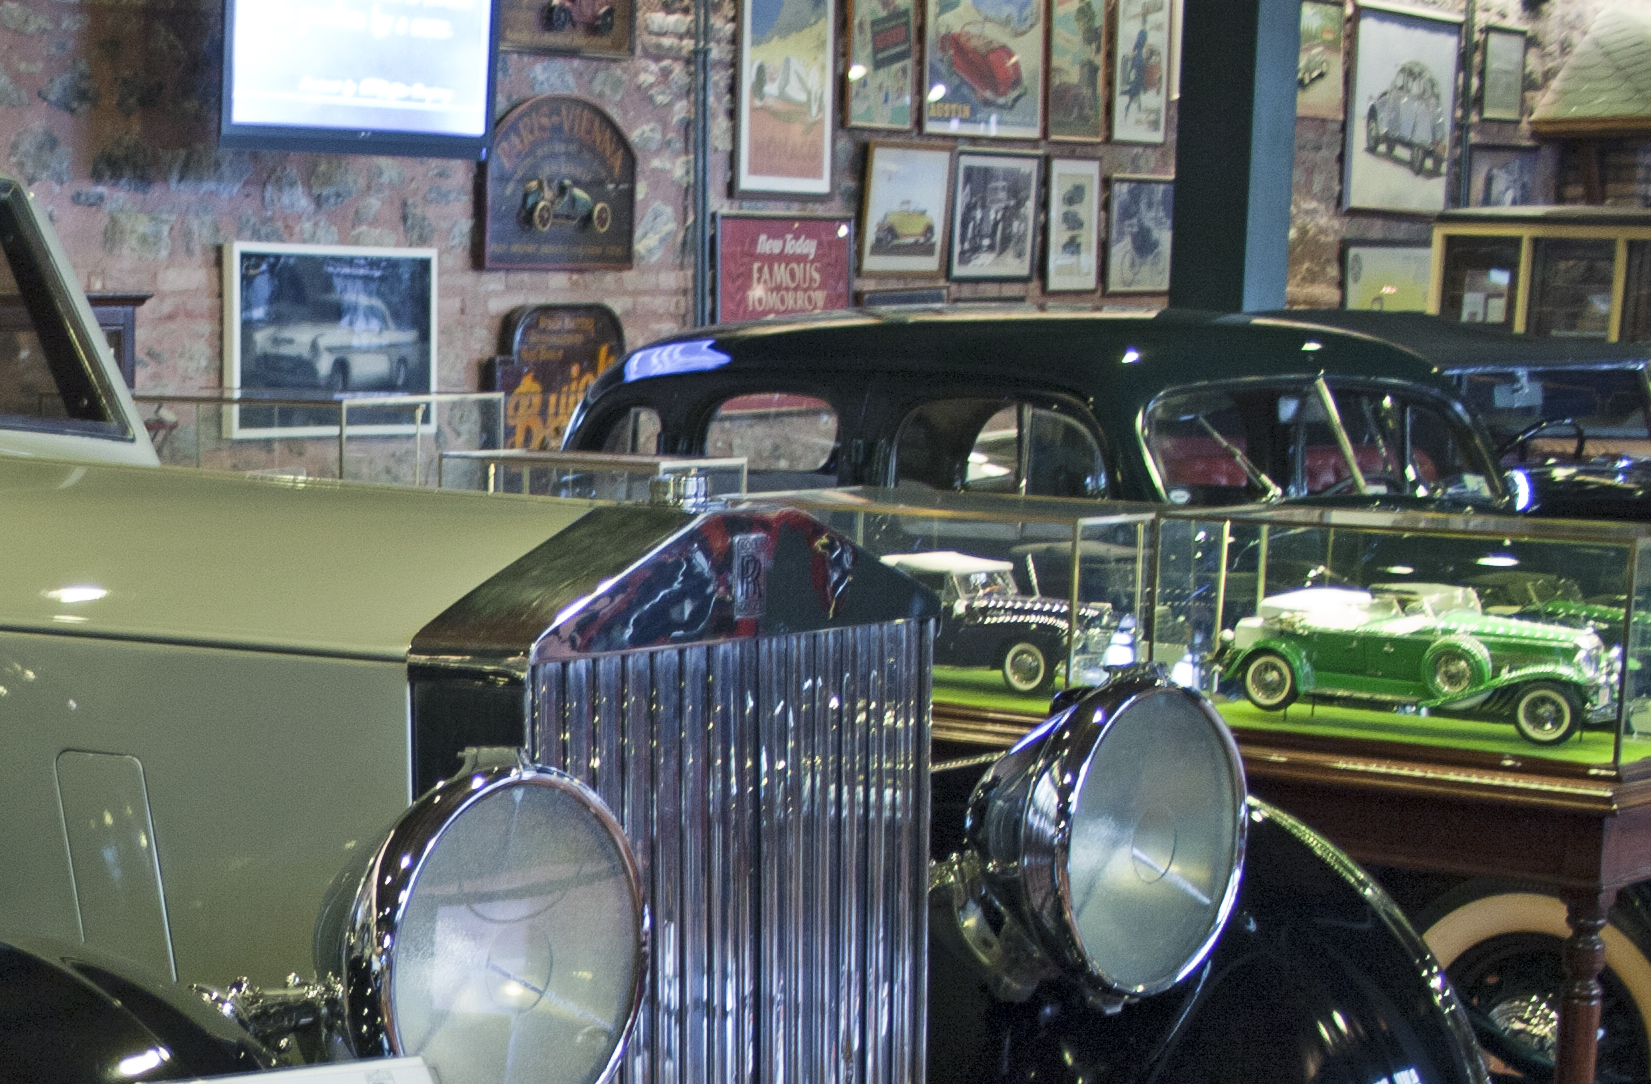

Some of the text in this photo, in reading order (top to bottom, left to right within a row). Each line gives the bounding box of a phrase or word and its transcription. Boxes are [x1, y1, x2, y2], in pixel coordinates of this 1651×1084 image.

[784, 234, 817, 260] Today
[752, 261, 822, 289] FAMOUS
[746, 289, 828, 312] TOMORROW
